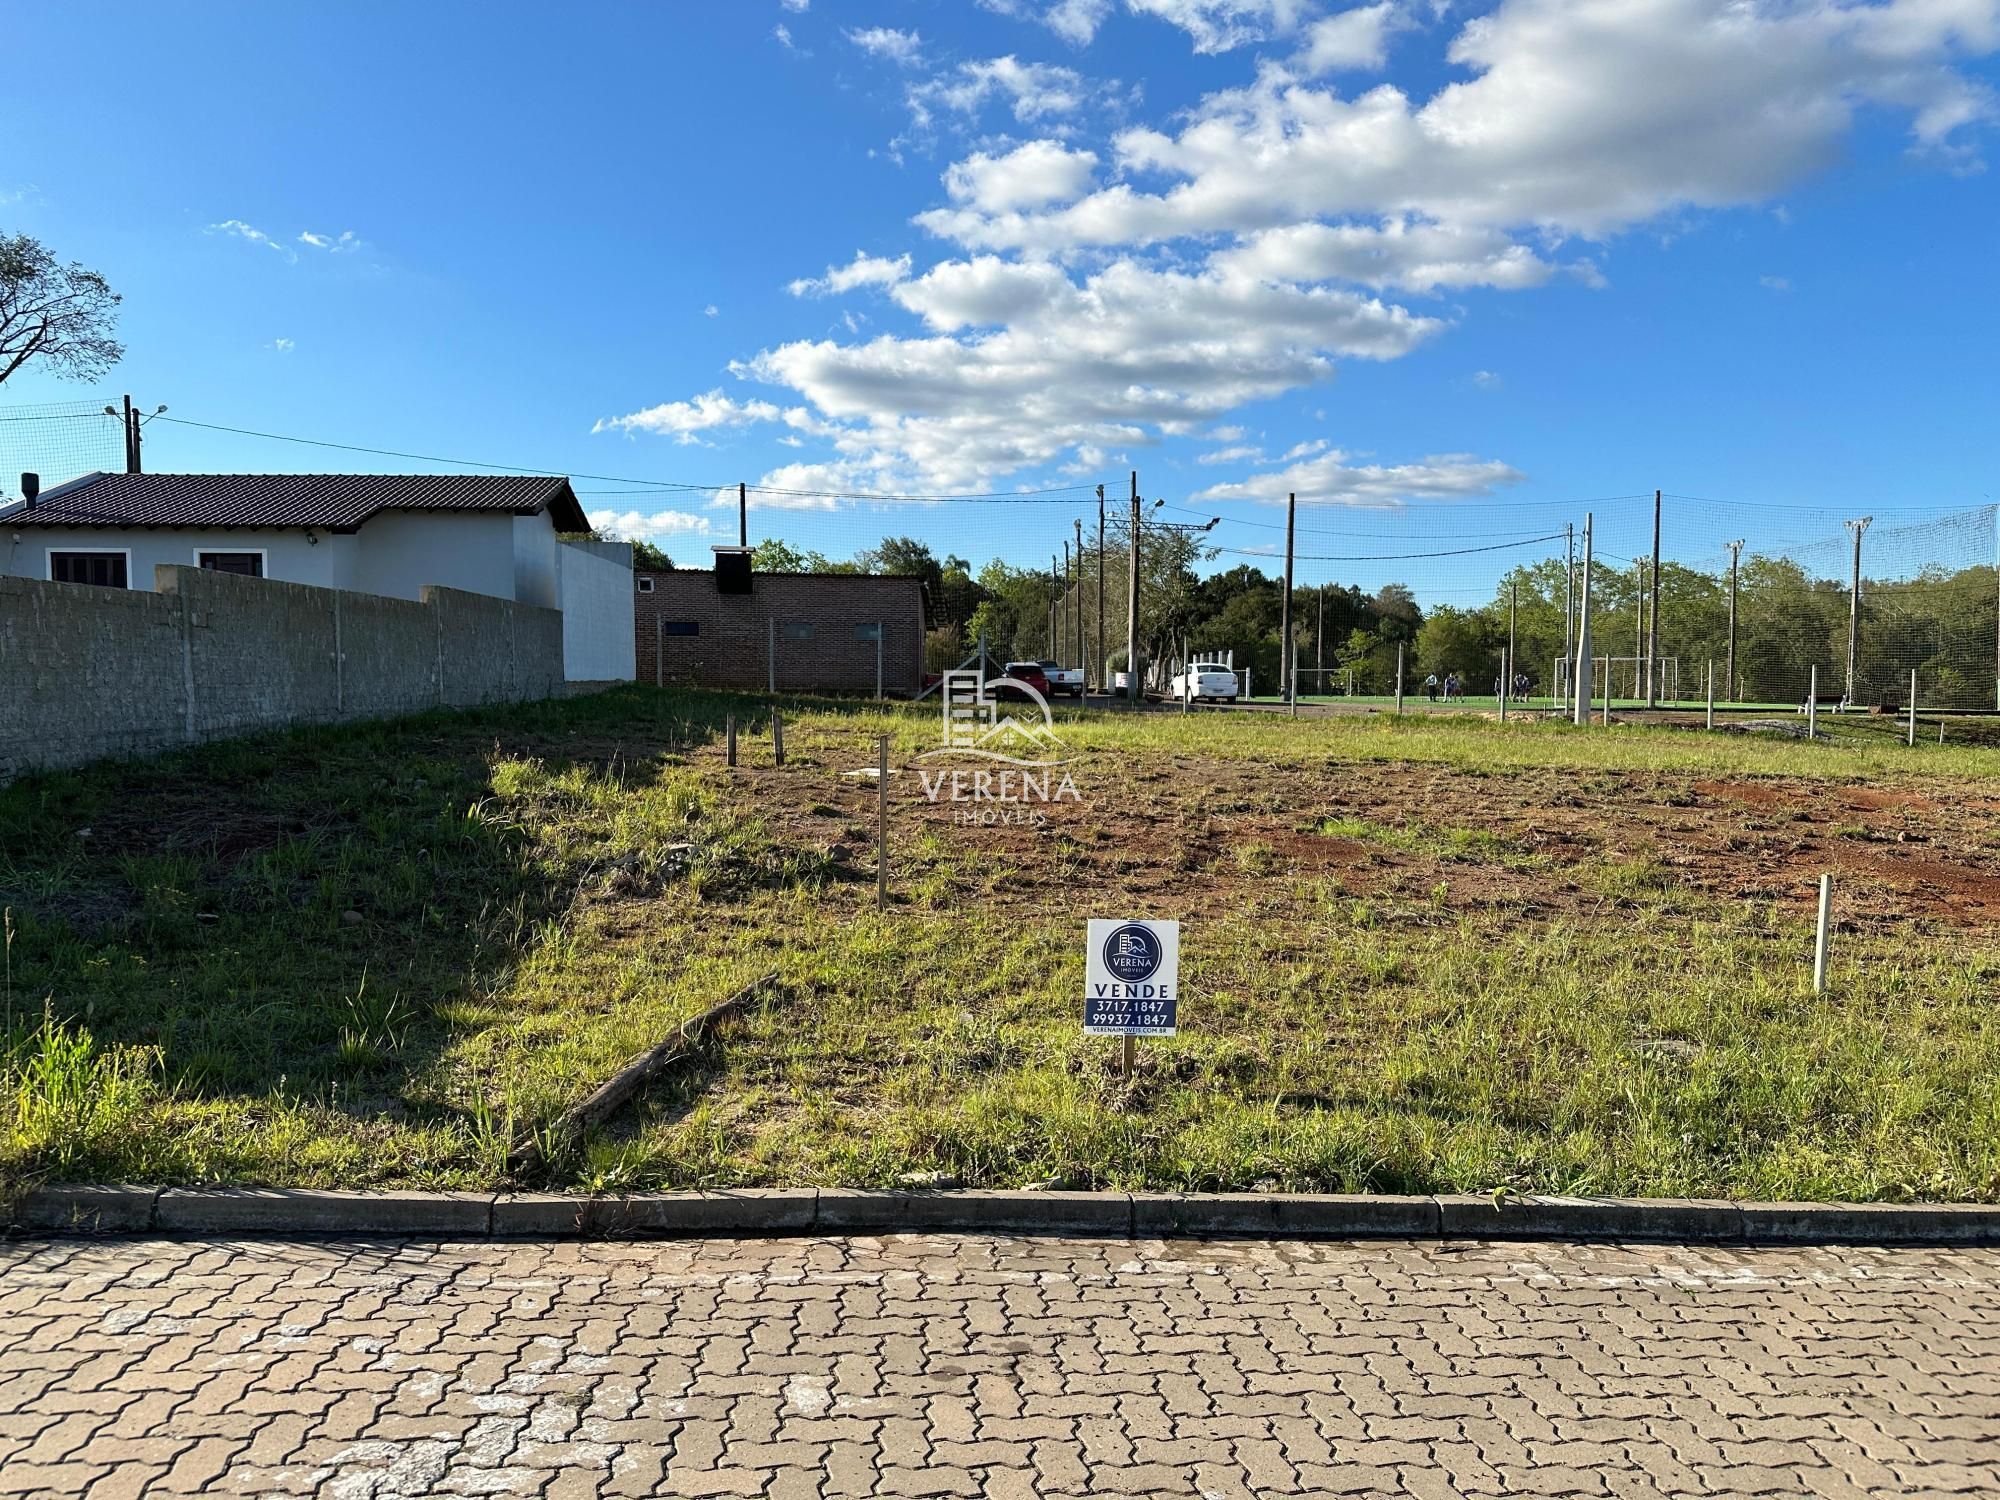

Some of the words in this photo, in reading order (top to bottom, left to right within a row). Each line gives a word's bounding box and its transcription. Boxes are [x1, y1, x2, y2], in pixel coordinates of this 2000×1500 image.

[1113, 957, 1152, 967] VERENA
[1095, 984, 1169, 998] VENDE
[1097, 1001, 1165, 1012] 3717.1847
[1092, 1013, 1168, 1025] 99937.1847
